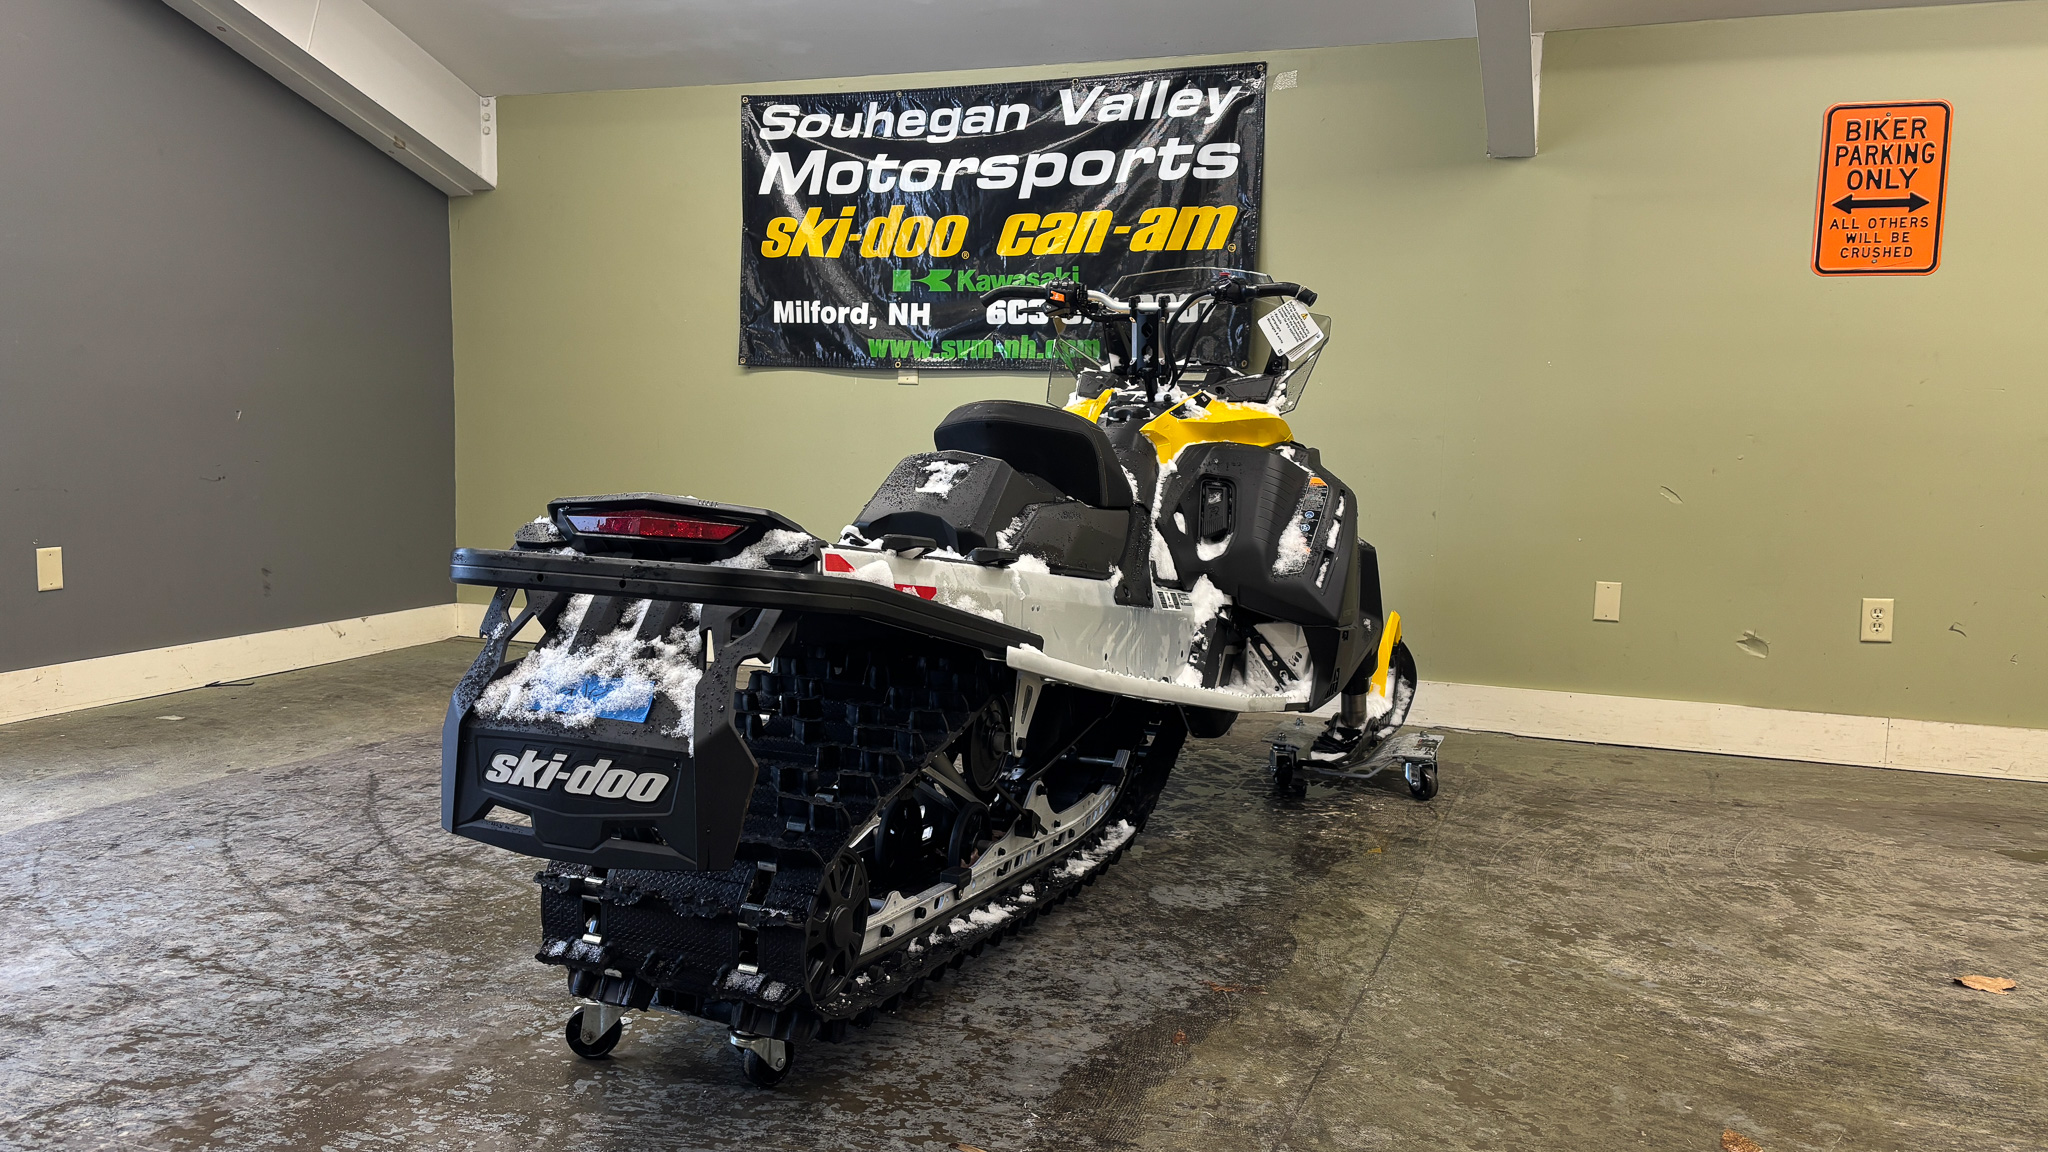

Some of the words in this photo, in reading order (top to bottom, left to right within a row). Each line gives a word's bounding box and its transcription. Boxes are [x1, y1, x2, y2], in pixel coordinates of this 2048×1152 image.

[759, 101, 1031, 144] Souhegan
[1059, 79, 1243, 126] Valley
[1846, 118, 1927, 141] BIKER
[1835, 142, 1936, 166] PARKING
[758, 137, 1241, 199] Motorsports
[1847, 168, 1919, 190] ONLY
[1830, 218, 1859, 230] ALL
[1868, 216, 1929, 229] OTHERS
[1846, 232, 1882, 244] WILL
[1891, 231, 1910, 243] BE
[1840, 246, 1913, 259] CRUSHED
[773, 301, 877, 329] Milford,
[888, 302, 931, 326] NH
[485, 749, 669, 802] ski-doo
